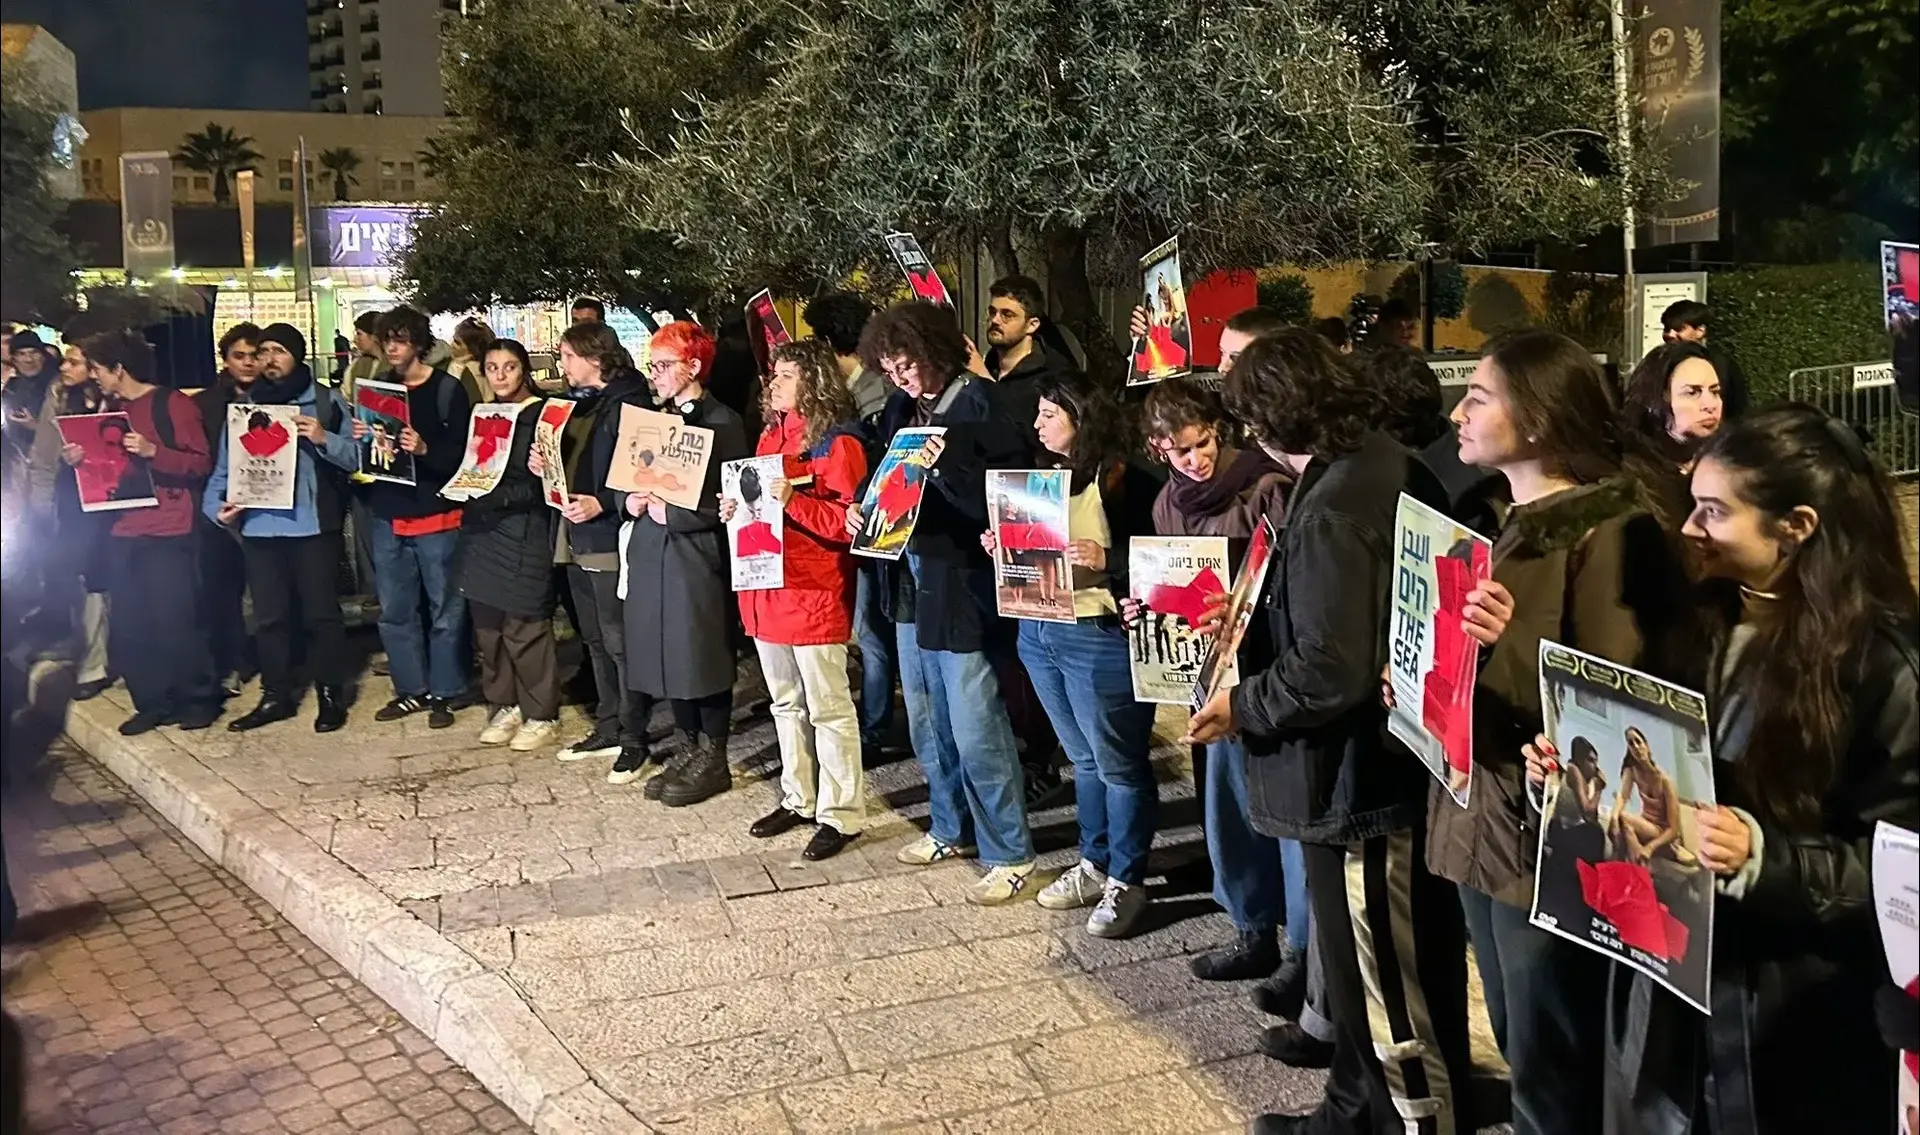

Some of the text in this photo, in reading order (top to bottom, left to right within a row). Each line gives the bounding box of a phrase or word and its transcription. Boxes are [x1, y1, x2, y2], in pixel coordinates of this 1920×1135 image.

[1197, 557, 1221, 569] אפס
[1398, 565, 1429, 616] הים
[1397, 605, 1426, 651] THE
[1394, 637, 1419, 684] SEA
